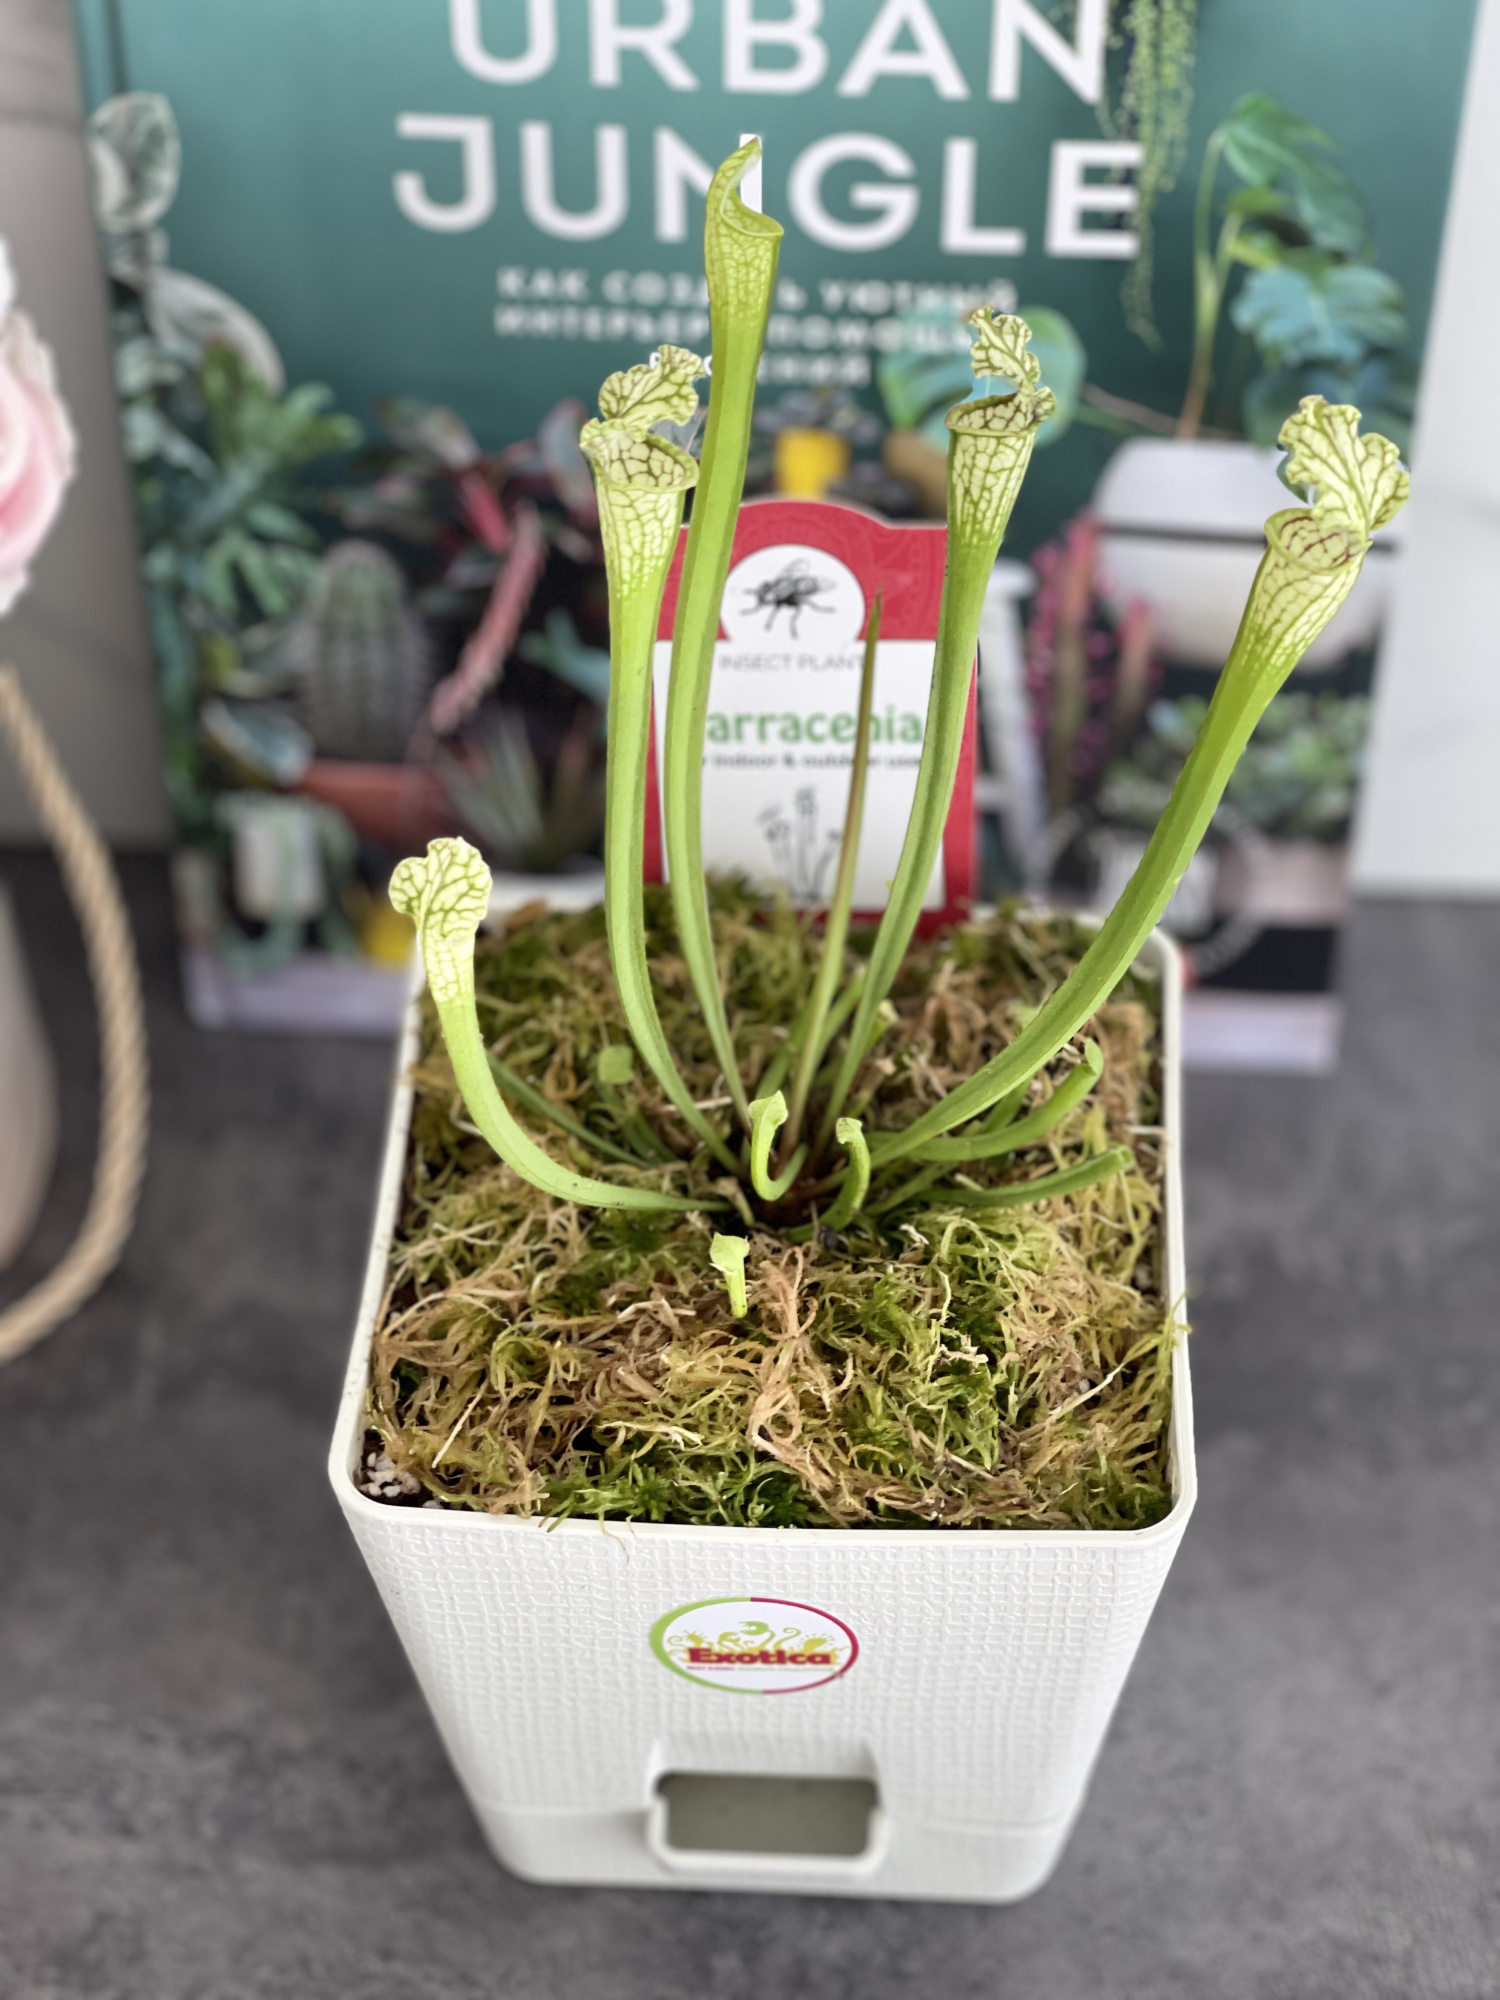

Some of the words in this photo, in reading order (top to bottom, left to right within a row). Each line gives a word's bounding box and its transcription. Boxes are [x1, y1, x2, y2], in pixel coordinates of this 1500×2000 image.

[451, 0, 1108, 102] URBAN
[395, 113, 1145, 256] JUNGLE
[497, 268, 589, 299] КАК
[719, 654, 793, 671] INSECT
[797, 655, 865, 672] PLANT
[706, 705, 923, 743] arracenia
[688, 1648, 831, 1665] Exotica
